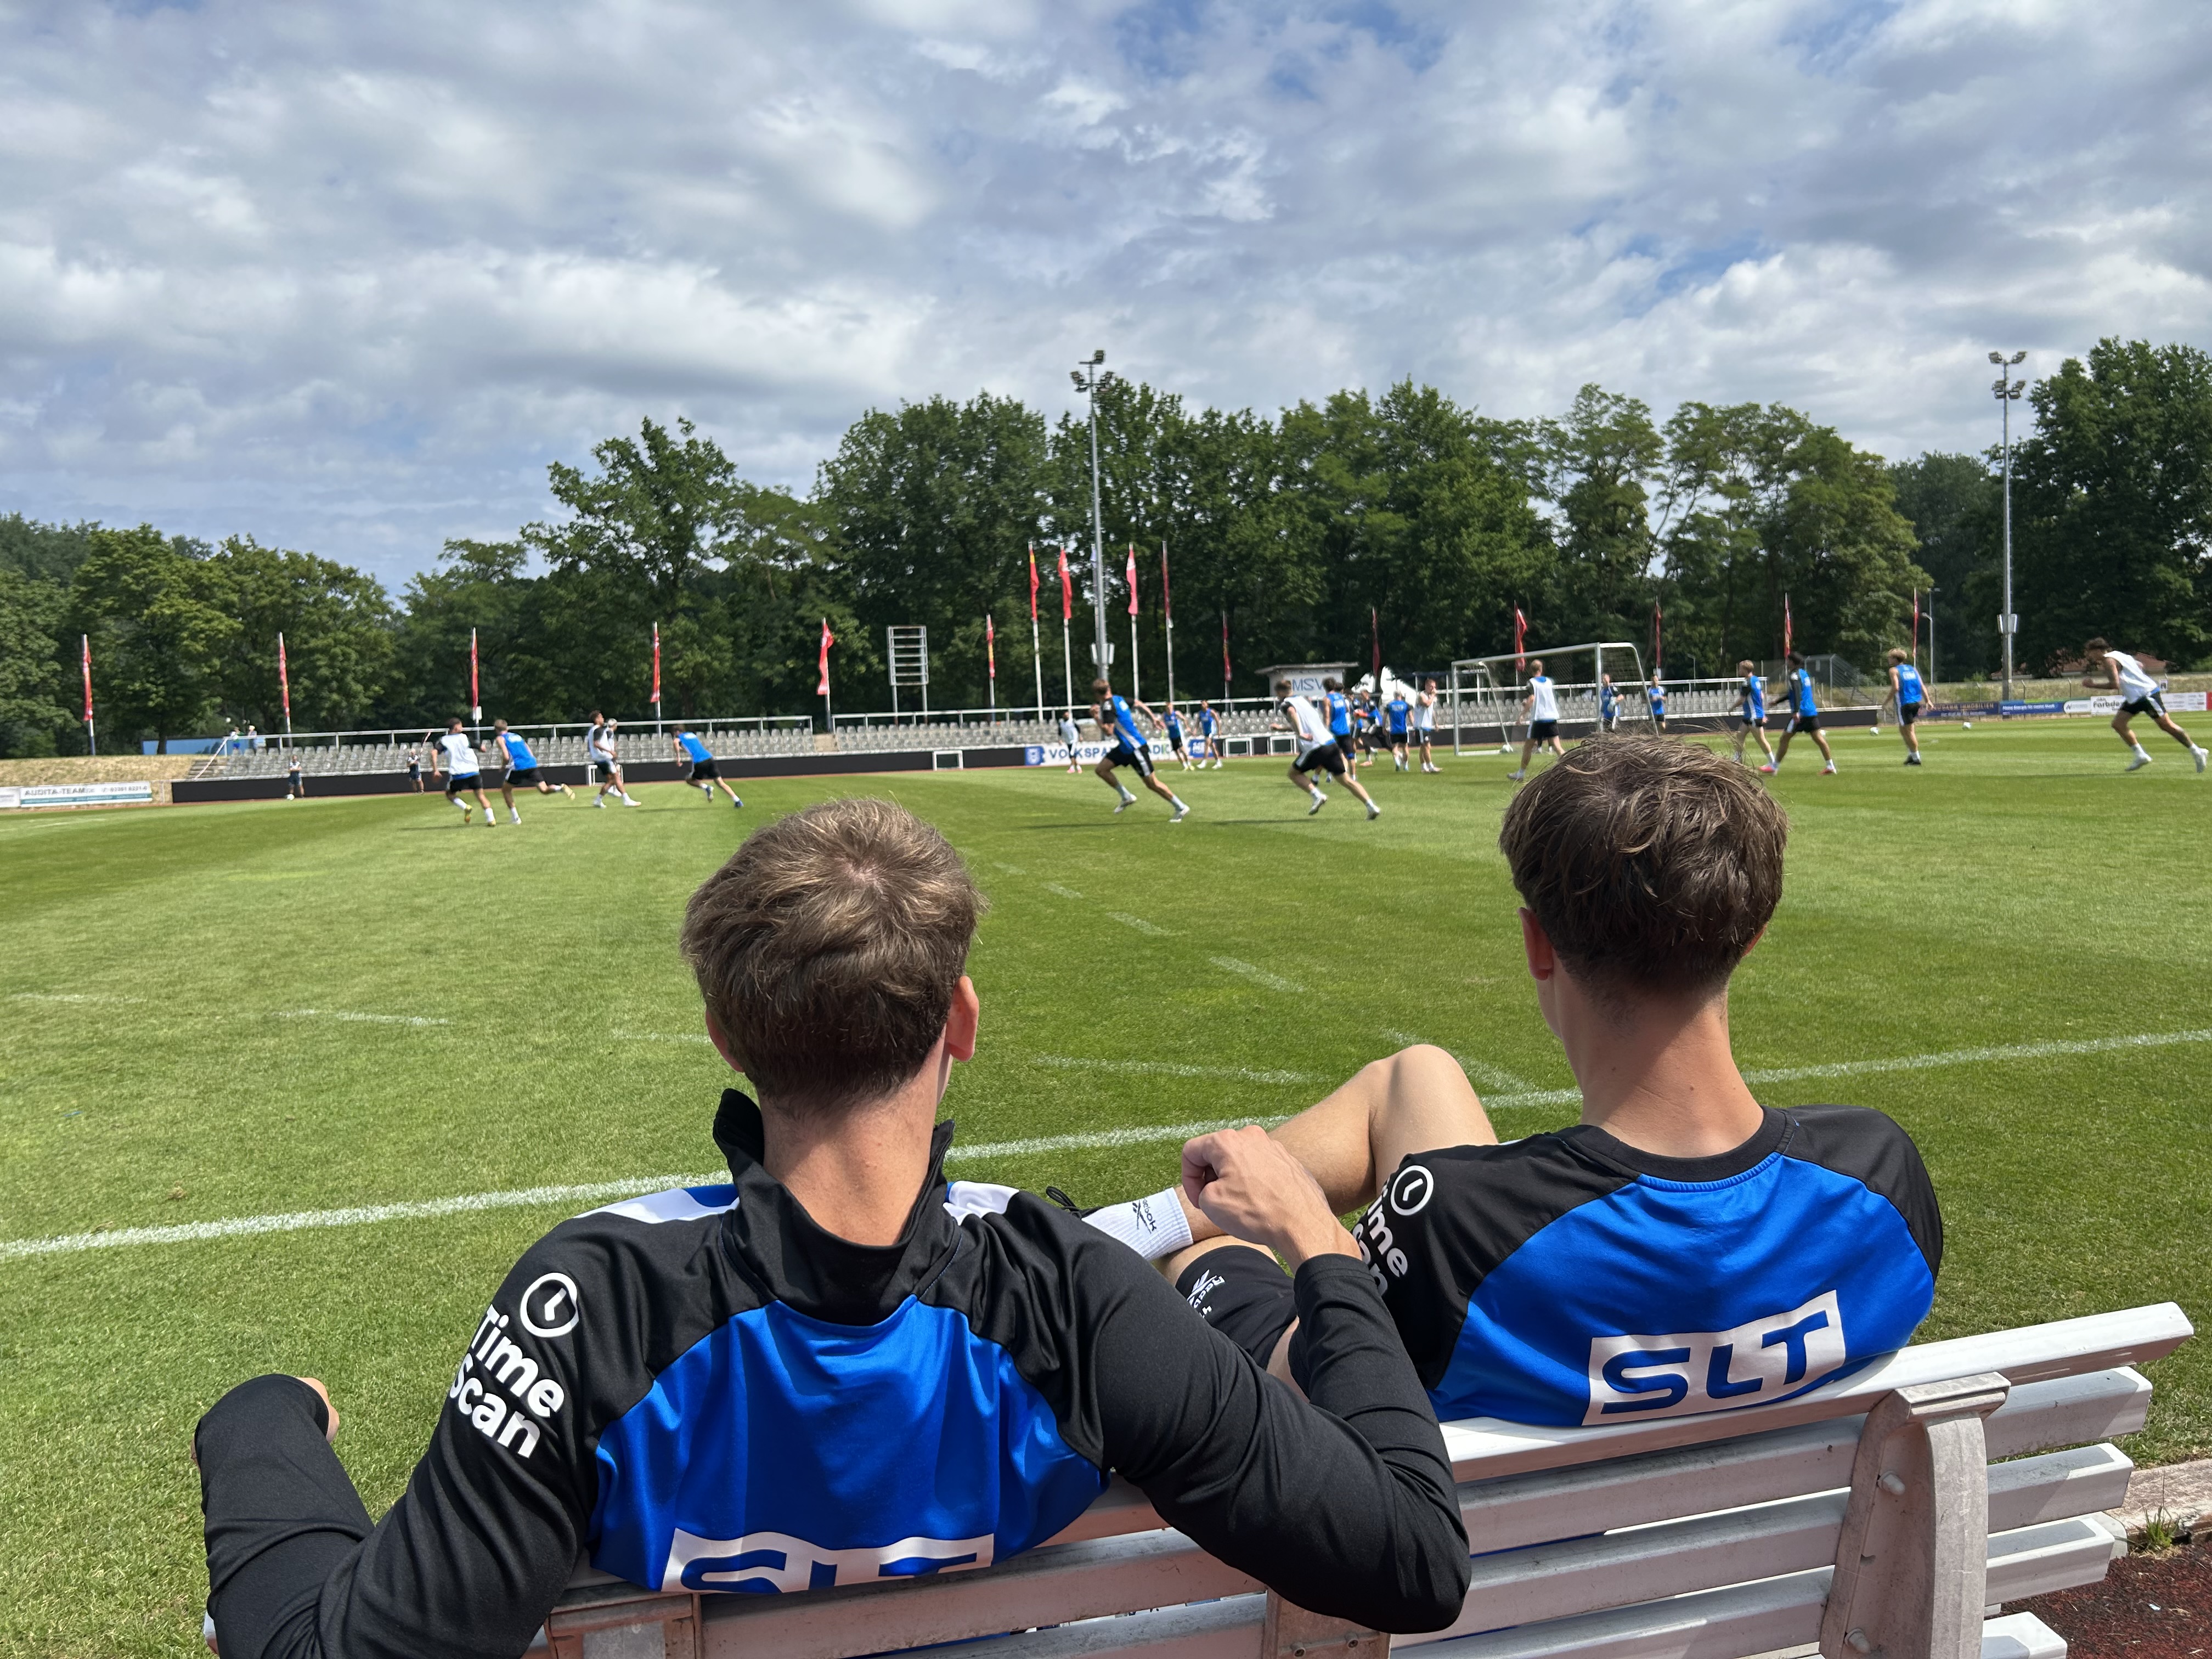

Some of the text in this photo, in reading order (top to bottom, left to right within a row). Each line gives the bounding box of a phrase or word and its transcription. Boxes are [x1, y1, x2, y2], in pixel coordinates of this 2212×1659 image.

[1142, 1198, 1157, 1232] eebok
[1193, 1276, 1225, 1309] Reeb
[471, 1304, 565, 1418] Time
[1600, 1310, 1830, 1414] SLT
